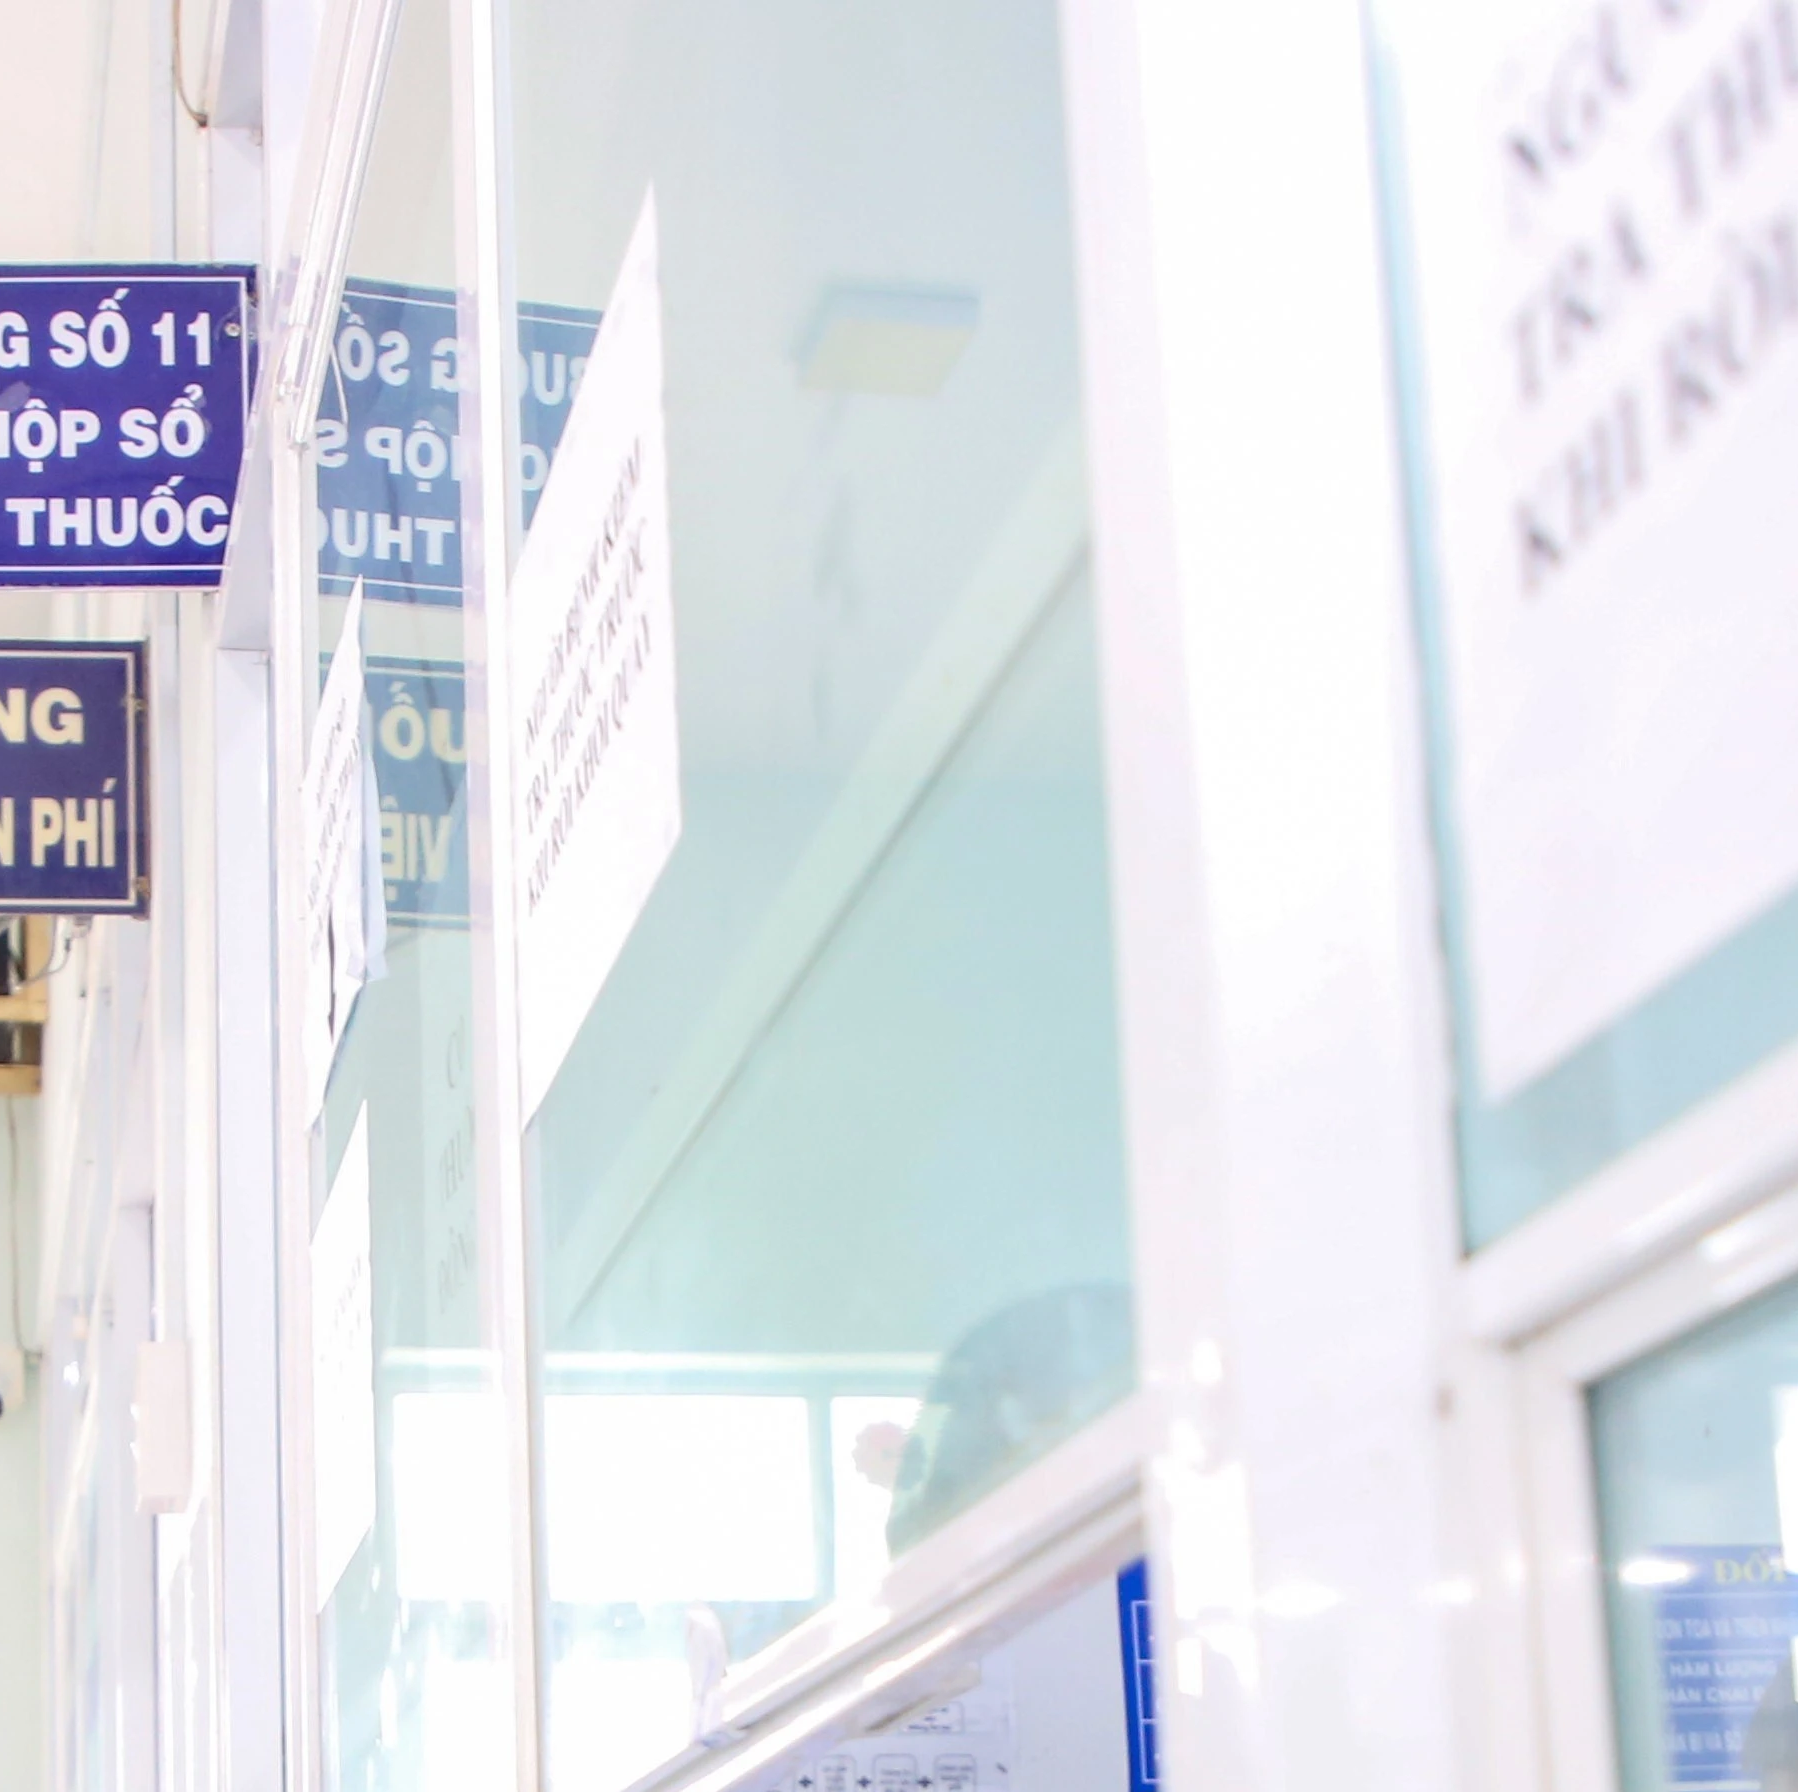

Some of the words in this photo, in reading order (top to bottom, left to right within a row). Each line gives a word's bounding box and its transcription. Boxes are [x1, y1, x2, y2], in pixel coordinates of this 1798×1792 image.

[49, 288, 130, 369] SỐ
[152, 312, 213, 367] 11
[118, 384, 204, 458] SỔ
[6, 483, 229, 548] THUỐC
[30, 778, 116, 867] PHÍ
